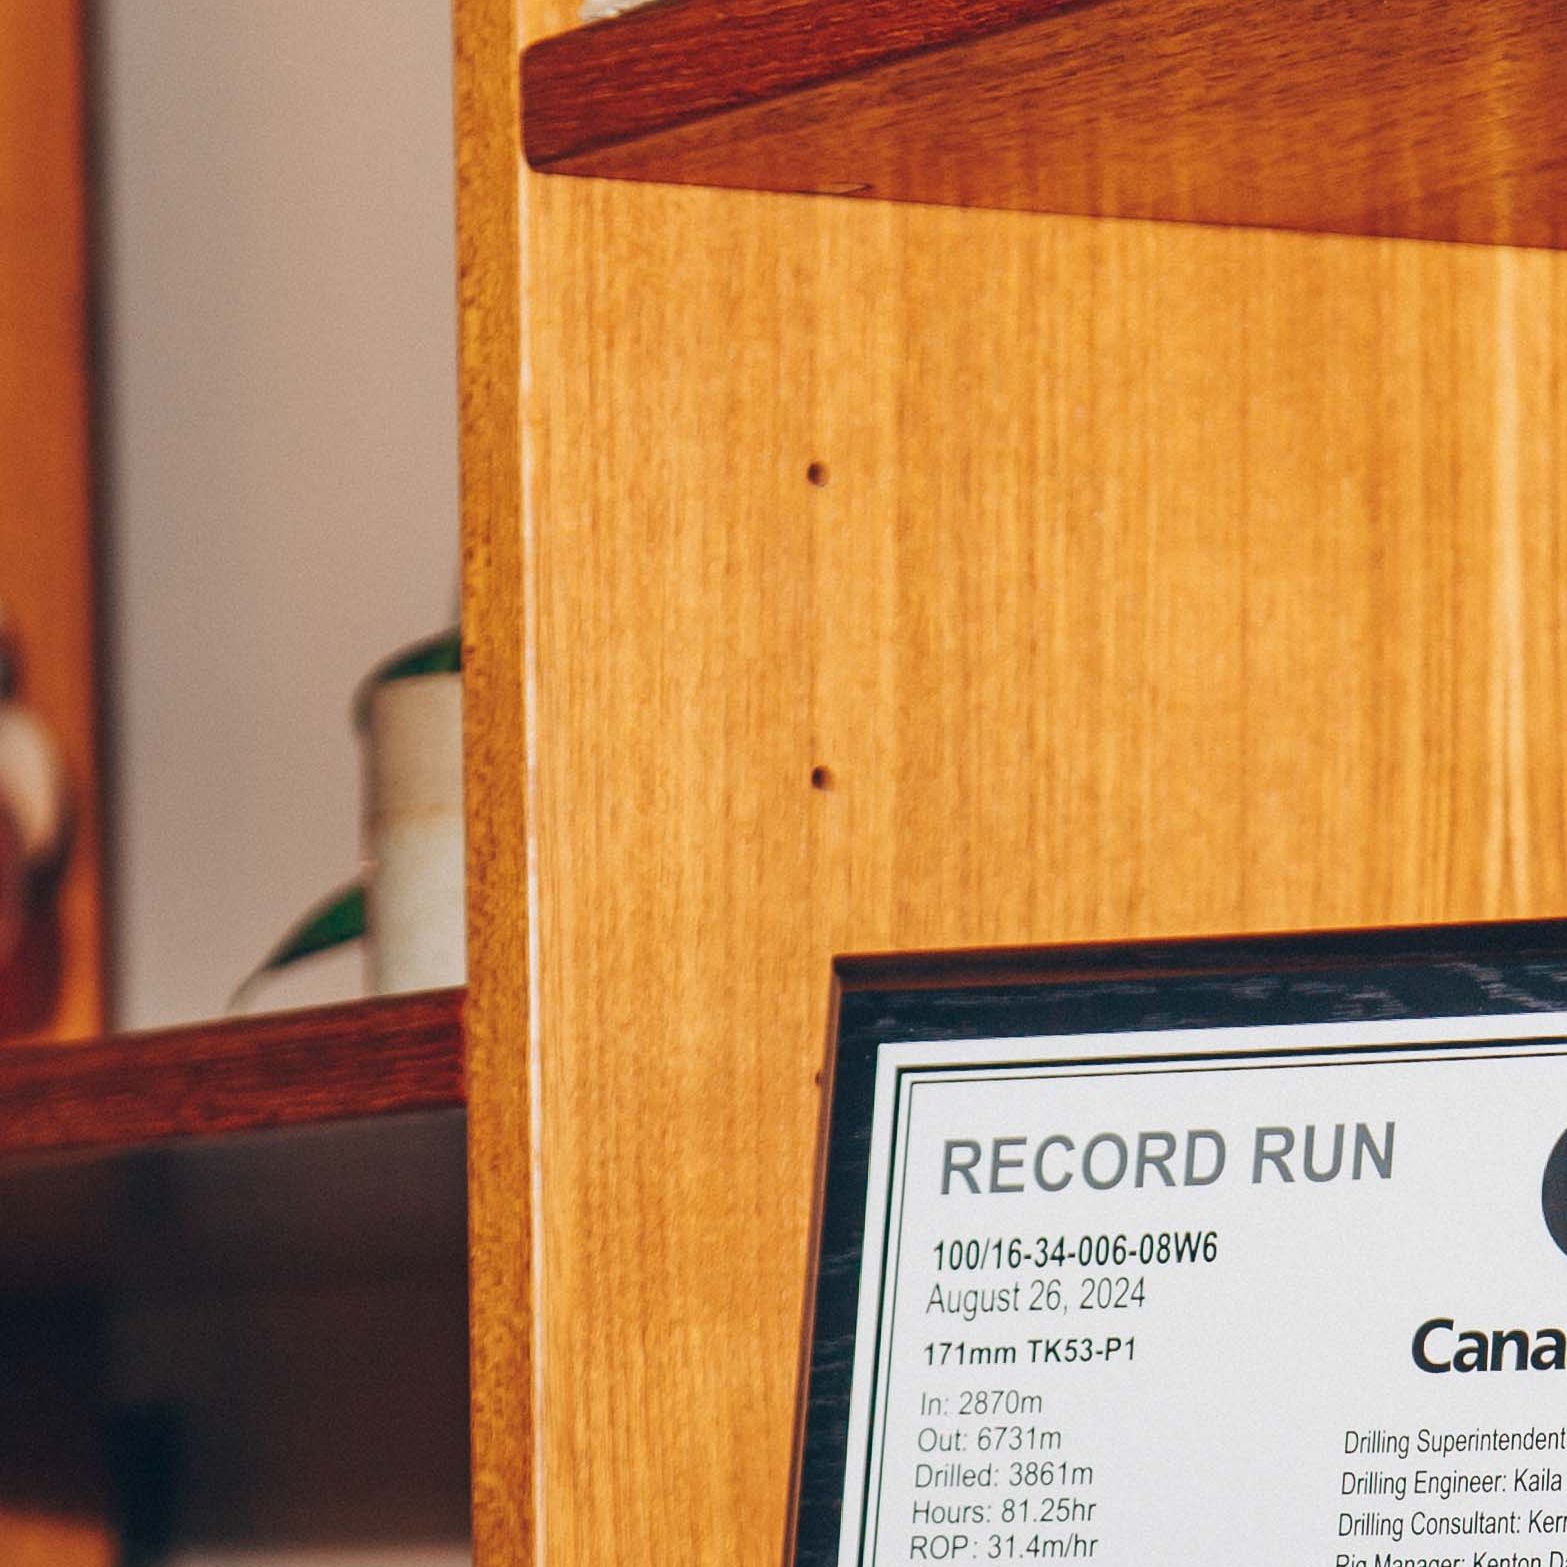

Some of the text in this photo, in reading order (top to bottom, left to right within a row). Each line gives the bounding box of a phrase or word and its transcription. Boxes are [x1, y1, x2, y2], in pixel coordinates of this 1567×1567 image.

[941, 1122, 1395, 1195] RECORD RUN
[933, 1230, 1219, 1272] 100/16-34-006-08W6
[924, 1275, 1146, 1323] August 26, 2024
[924, 1336, 1136, 1367] 171mm TK53-P1
[920, 1389, 1043, 1417] In: 2870m
[916, 1424, 1063, 1453] Out: 6731m
[1343, 1429, 1411, 1460] Drilling
[914, 1459, 1094, 1490] Drilled: 3861m
[1340, 1470, 1408, 1502] Drilling
[1412, 1468, 1507, 1501] Engineer:
[1513, 1467, 1563, 1493] Kaila
[911, 1496, 1098, 1525] Hours: 81.25hr
[1337, 1511, 1405, 1543] Drilling
[1409, 1510, 1522, 1537] Consultant:
[908, 1532, 1099, 1561] ROP: 31.4m/hr
